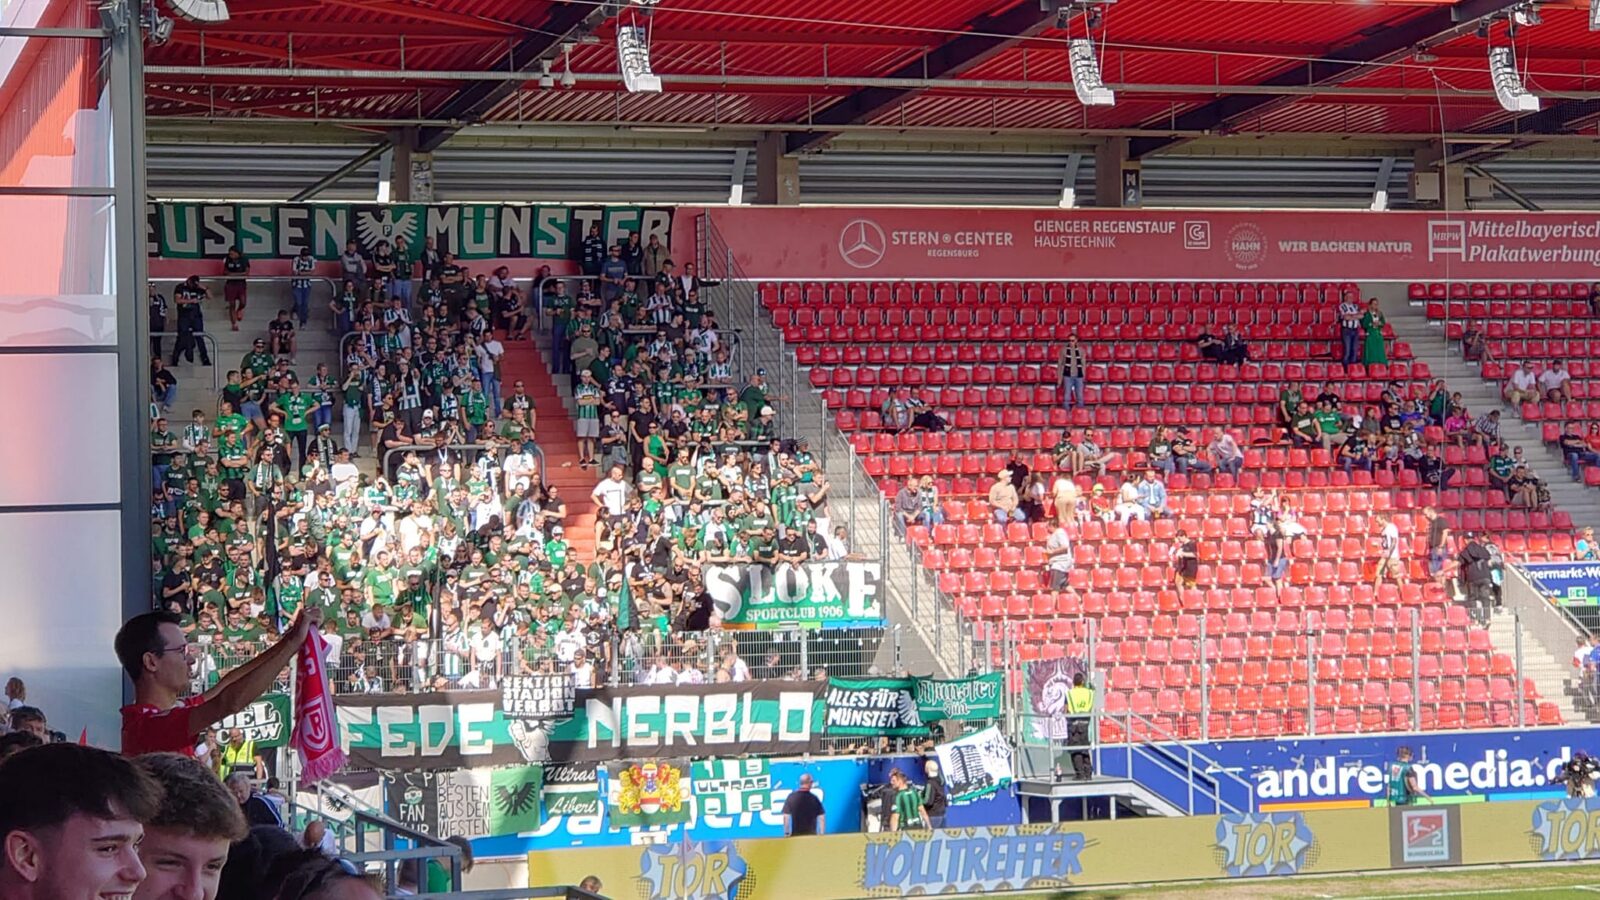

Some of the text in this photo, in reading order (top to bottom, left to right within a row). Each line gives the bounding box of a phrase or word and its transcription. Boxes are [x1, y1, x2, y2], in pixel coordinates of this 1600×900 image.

[1127, 189, 1136, 201] 2
[1034, 220, 1176, 234] GIENGER REGENSTAUF
[892, 231, 1013, 246] STERN CENTER
[1034, 235, 1116, 248] HAUSTECHNIK
[1432, 231, 1461, 241] MBPW
[927, 249, 979, 257] REGENSBURG
[1232, 241, 1260, 251] HAHN
[1279, 241, 1413, 253] WIR BACKEN NATUR
[746, 606, 843, 621] SPORTCLUB 1906
[503, 676, 575, 689] SEKTION
[503, 687, 575, 700] STADION
[827, 688, 899, 708] ALLES FÜR
[503, 699, 574, 711] VERBOT
[586, 692, 814, 748] NERBLO
[828, 708, 899, 728] MÜNSTER
[215, 722, 280, 742] CEW
[546, 766, 597, 782] Ultras
[698, 778, 768, 793] ULTRAS
[438, 785, 489, 803] BESTEN
[399, 804, 425, 822] FAN
[439, 801, 491, 820] AUS DEM
[549, 797, 596, 813] Liberi
[439, 819, 491, 838] WESTEN
[1546, 808, 1600, 853] TOR
[1232, 821, 1295, 867] TOR
[865, 832, 1084, 889] VOLLTREFFER
[658, 852, 726, 899] TOR
